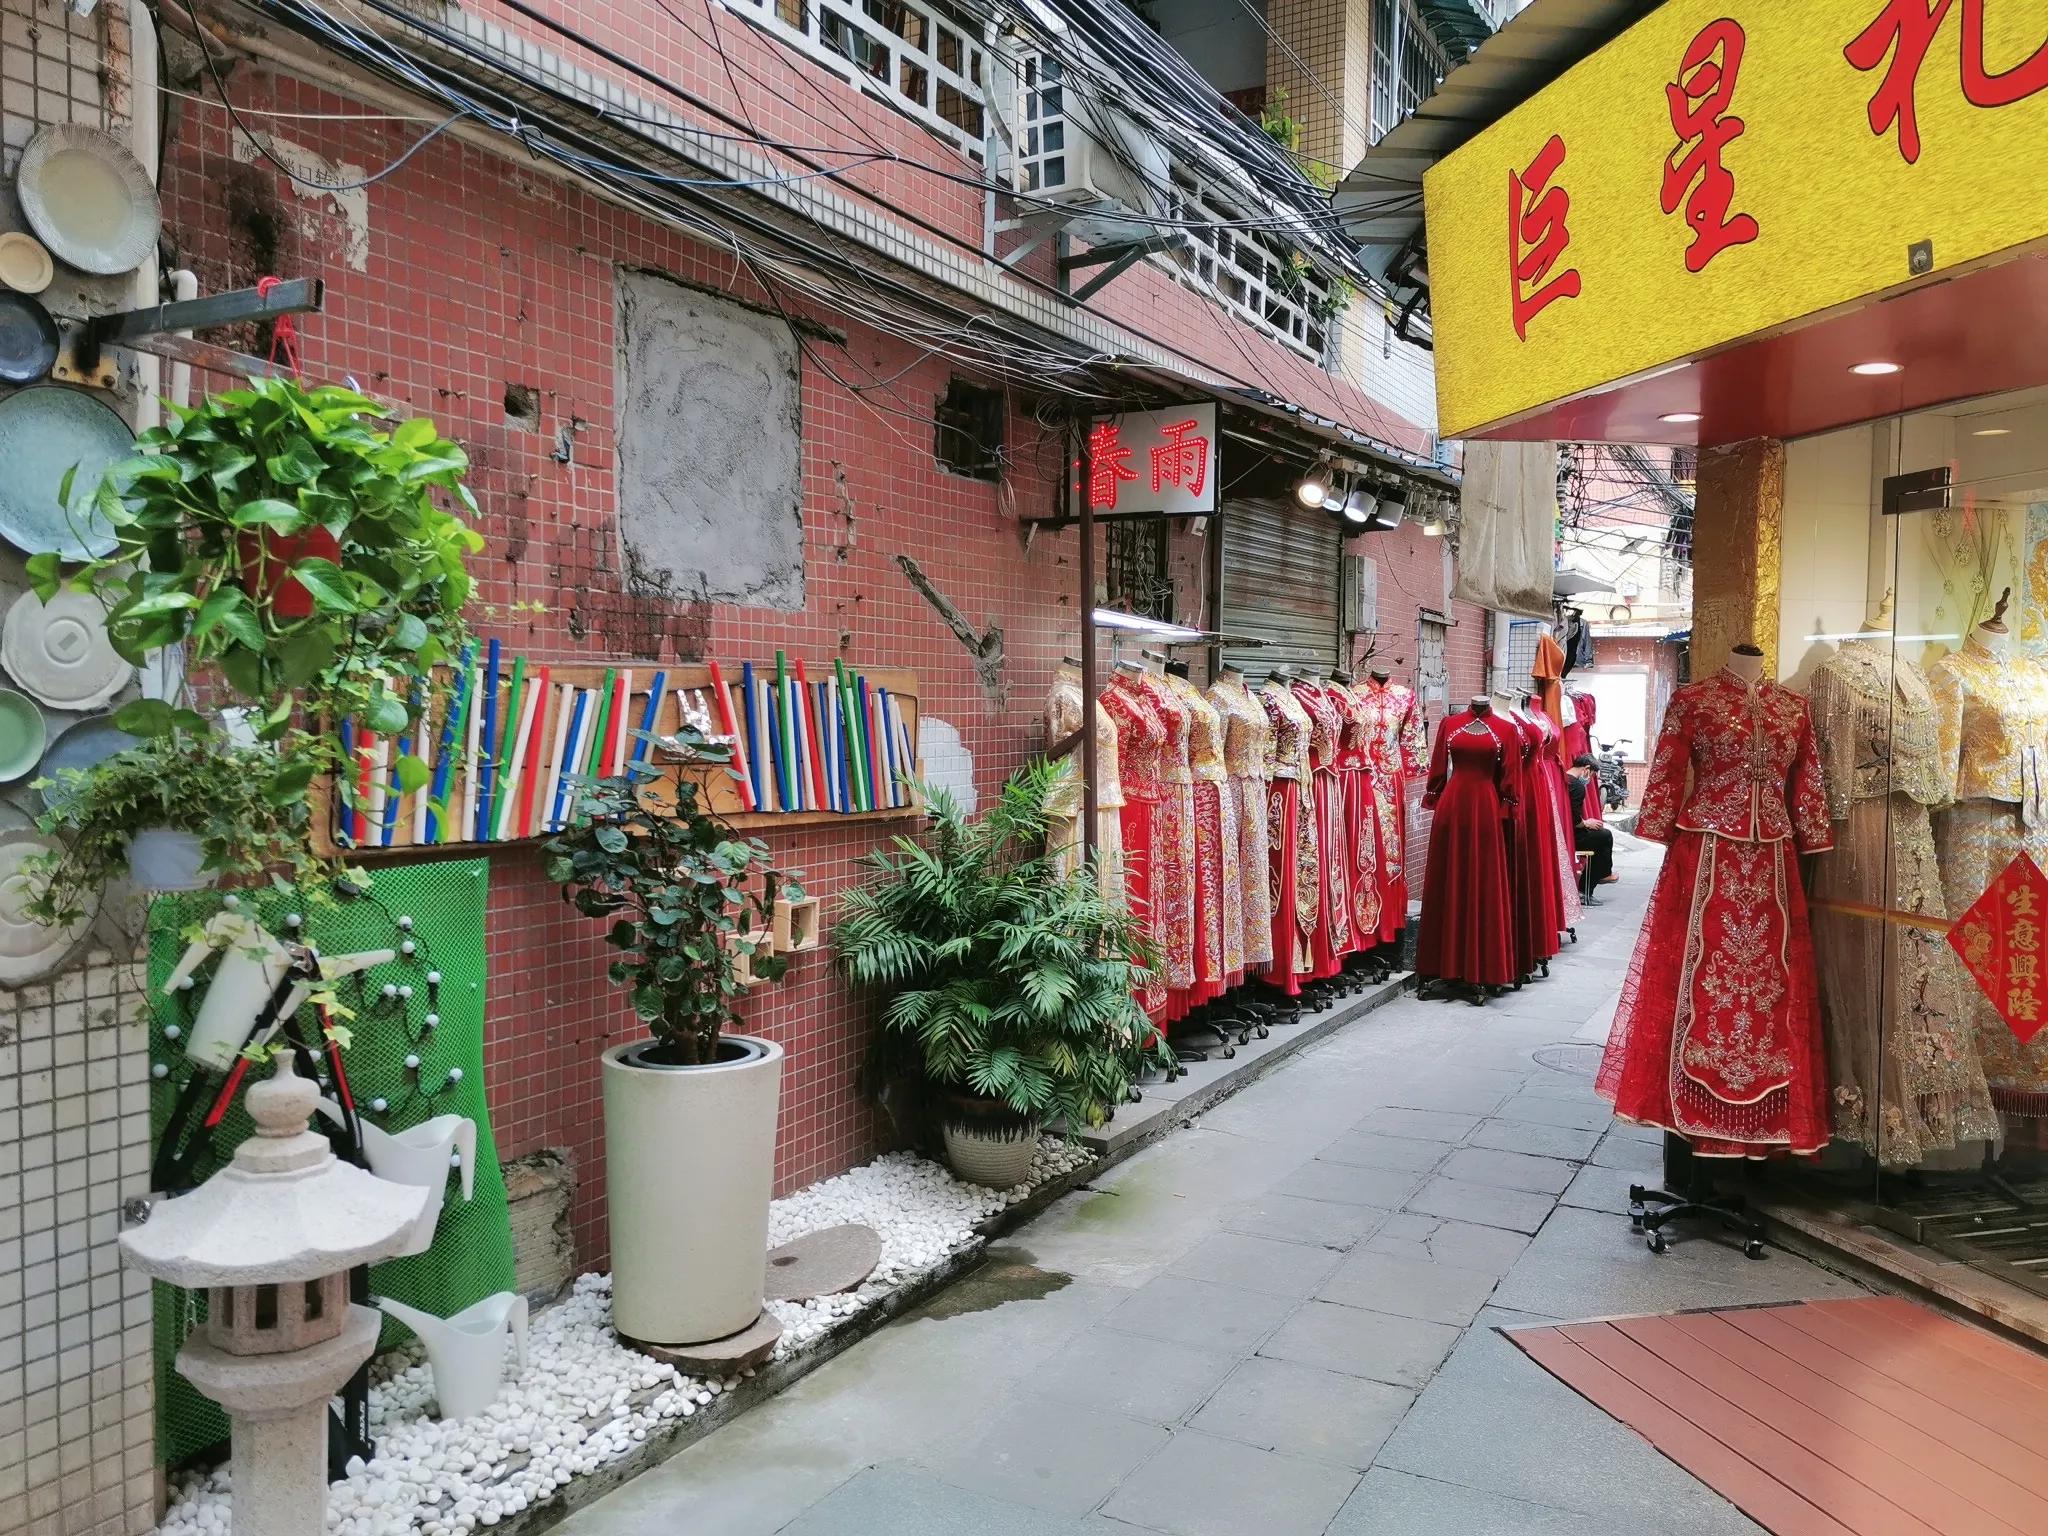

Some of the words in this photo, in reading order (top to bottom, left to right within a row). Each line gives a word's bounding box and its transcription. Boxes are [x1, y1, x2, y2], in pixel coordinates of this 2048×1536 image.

[1072, 419, 1209, 511] 春雨
[2006, 884, 2042, 1021] 生意興隆
